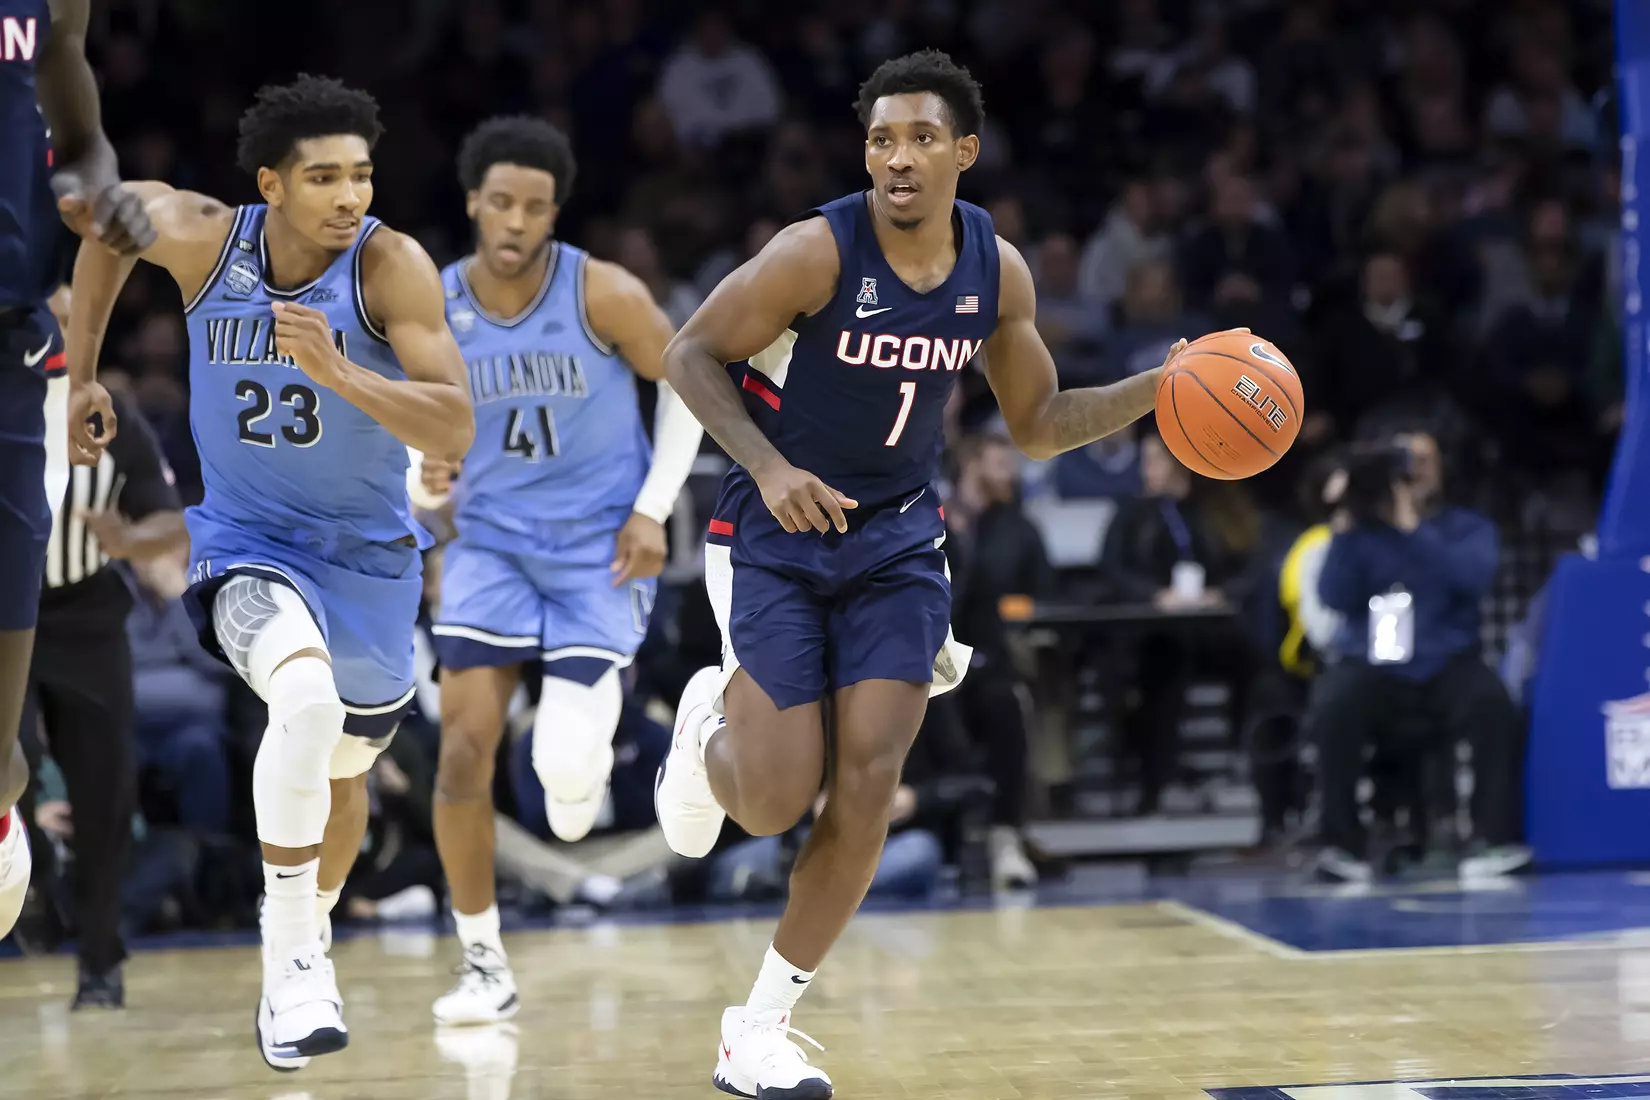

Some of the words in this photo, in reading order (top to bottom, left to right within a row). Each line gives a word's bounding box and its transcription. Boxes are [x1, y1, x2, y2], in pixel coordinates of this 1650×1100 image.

[468, 352, 590, 406] ILLANOVA
[1233, 374, 1288, 431] ELITE
[235, 379, 323, 449] 23
[503, 405, 561, 464] 41
[884, 381, 916, 447] 1
